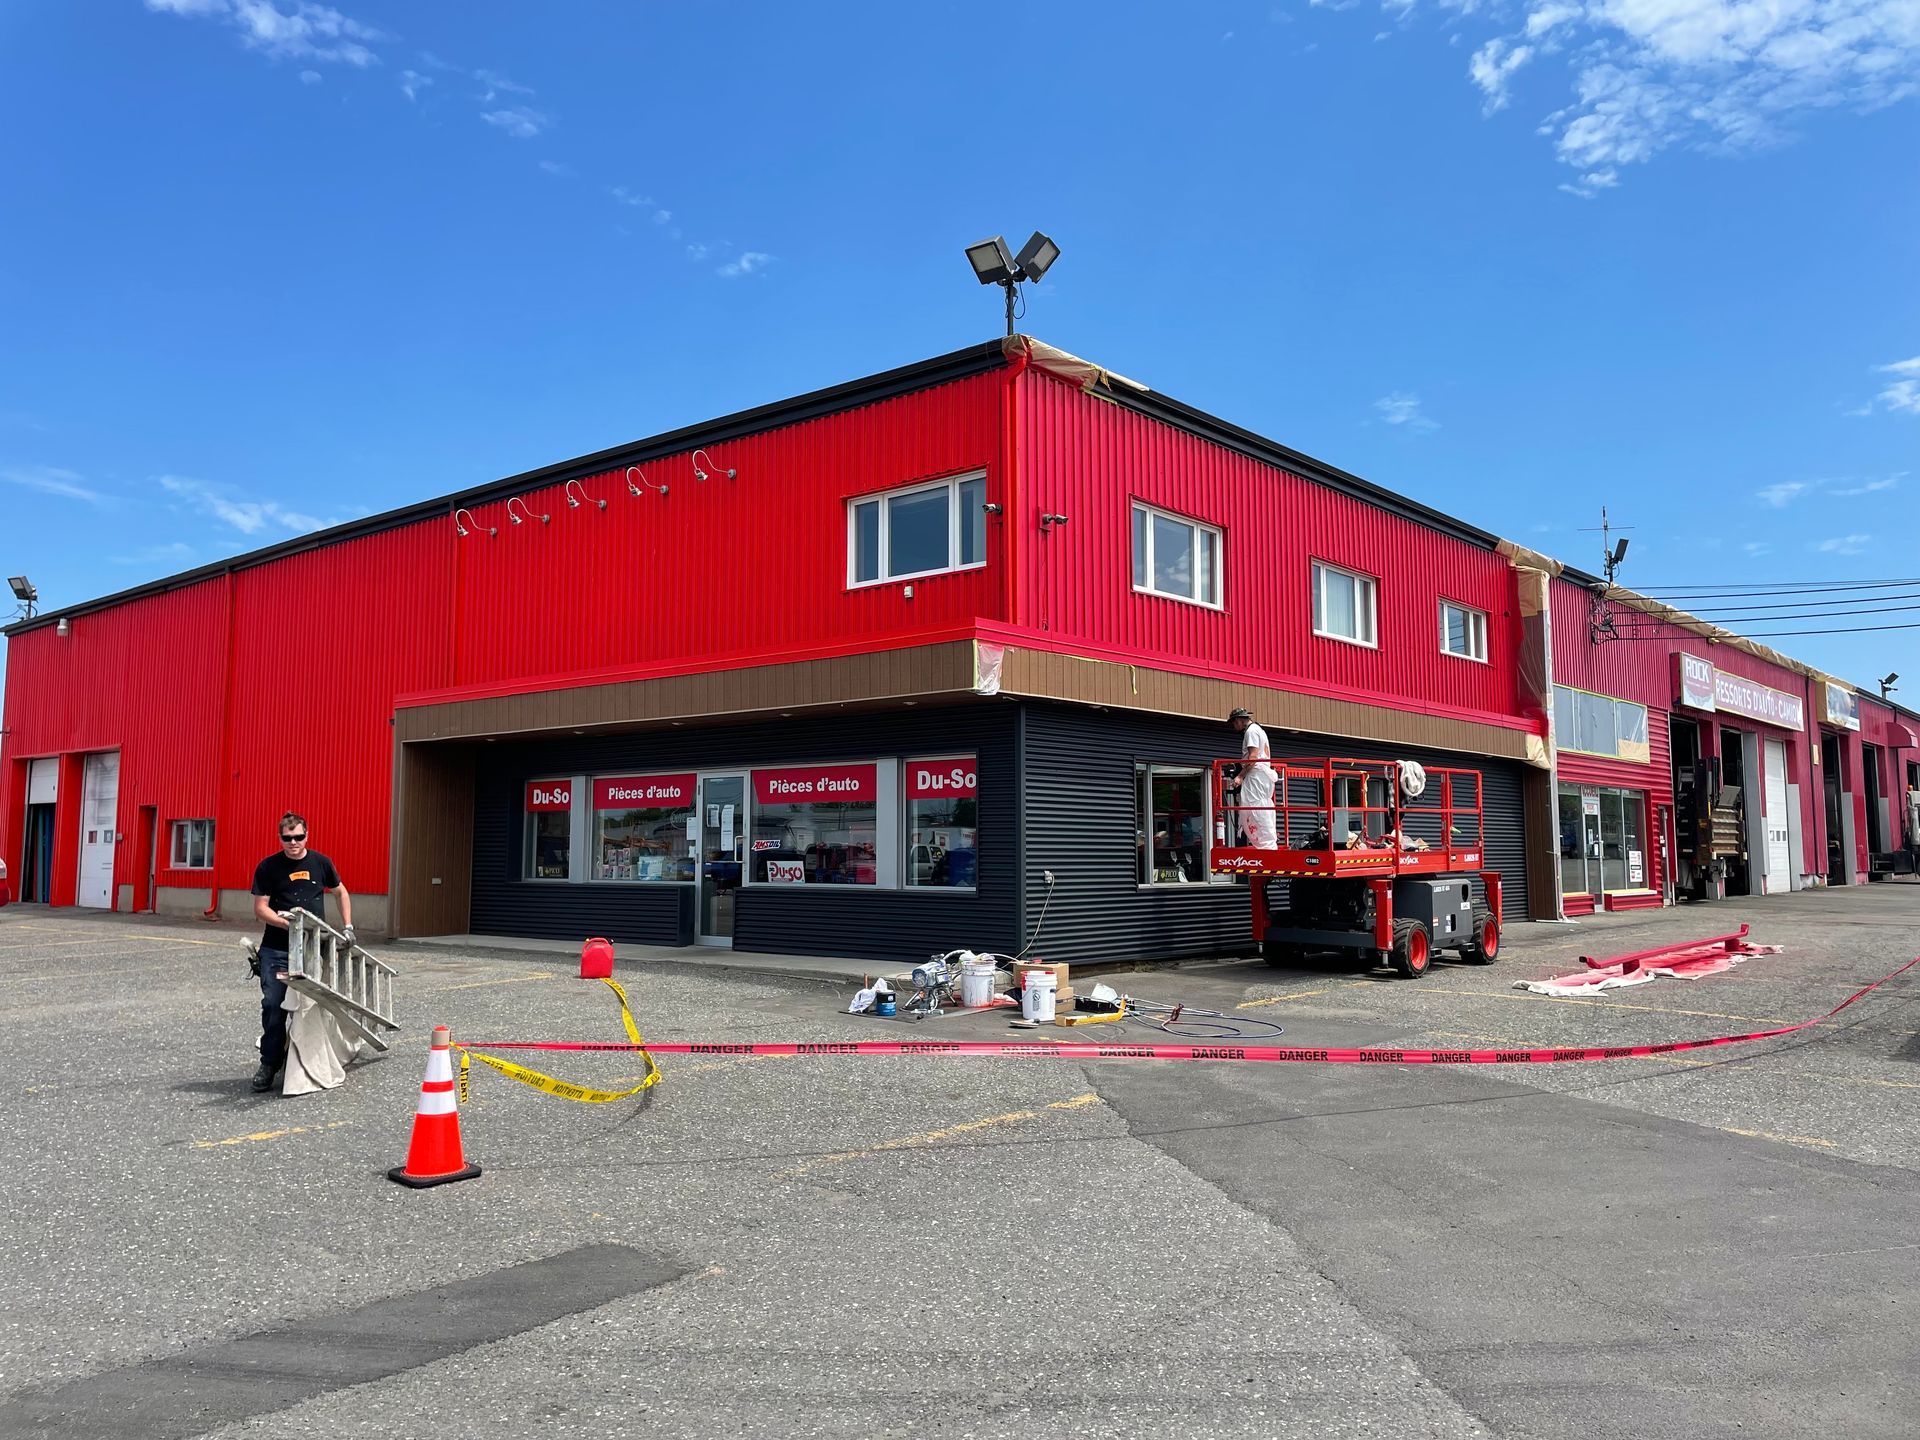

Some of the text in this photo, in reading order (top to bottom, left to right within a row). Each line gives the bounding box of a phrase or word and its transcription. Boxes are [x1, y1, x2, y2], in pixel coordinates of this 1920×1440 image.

[1686, 657, 1710, 683] ROCK
[1715, 678, 1752, 710] RESSORTS
[1753, 690, 1775, 716] D'AUTO
[769, 777, 860, 793] Pièces d’auto
[917, 768, 977, 790] Du-So
[532, 788, 569, 805] Du-So
[608, 785, 681, 800] Pièces d’auto
[754, 840, 780, 849] AMSOIL
[1218, 856, 1263, 867] SKYJACK
[690, 1045, 754, 1053] DANGER
[796, 1044, 859, 1054] DANGER
[1099, 1047, 1156, 1057] DANGER
[1191, 1048, 1245, 1059] DANGER
[1279, 1050, 1328, 1061] DANGER
[1359, 1051, 1404, 1062] DANGER
[1432, 1053, 1472, 1063] DANGER
[1496, 1053, 1531, 1062] DANGER
[1553, 1052, 1585, 1061] DANGER
[1603, 1049, 1633, 1058] DANGER
